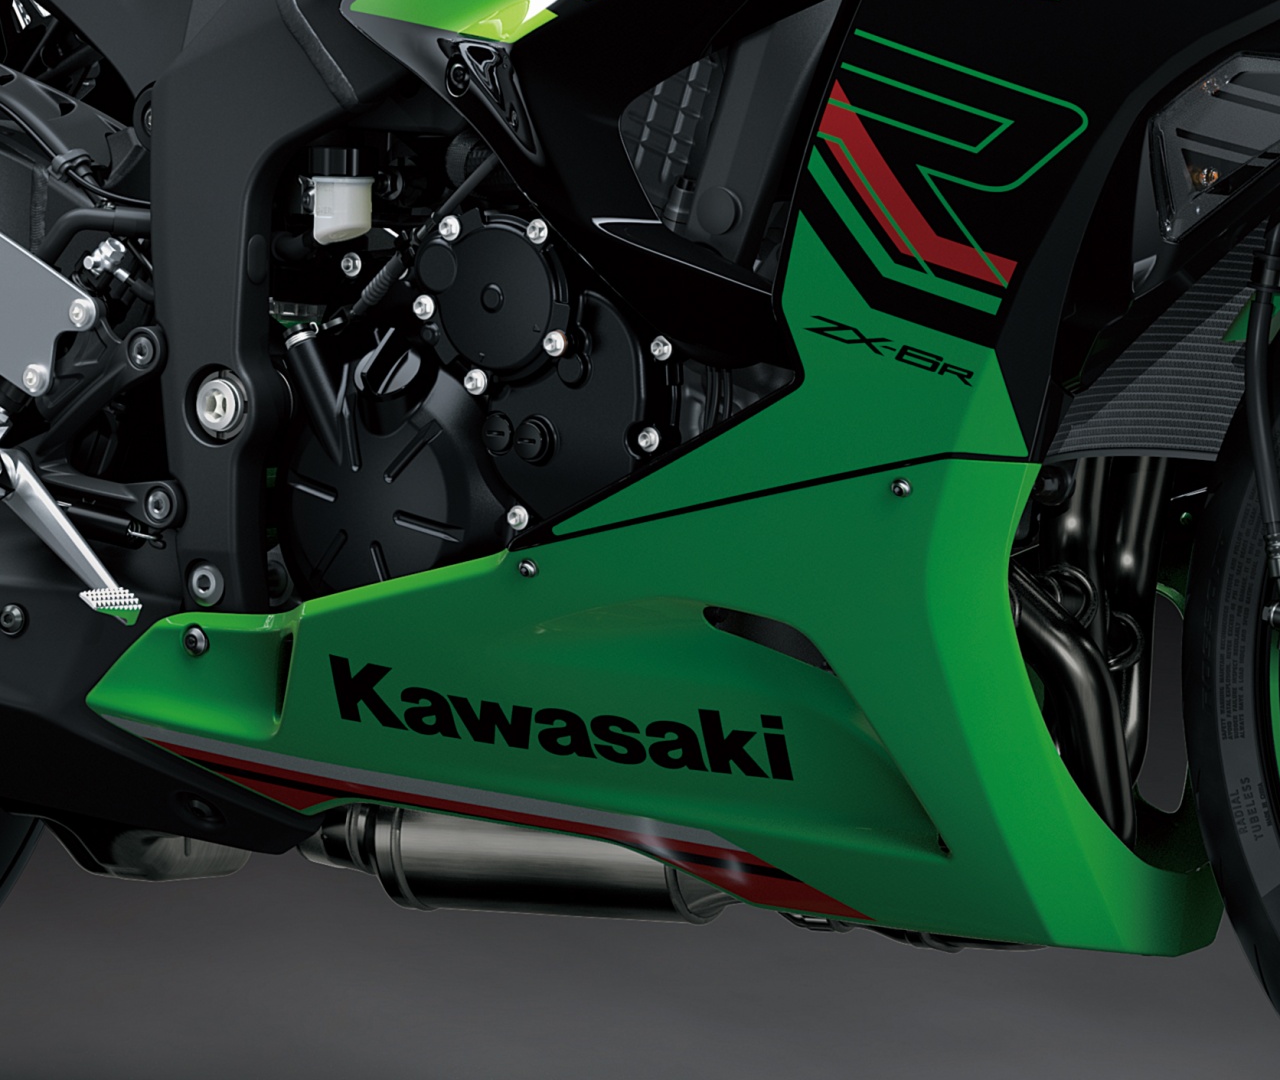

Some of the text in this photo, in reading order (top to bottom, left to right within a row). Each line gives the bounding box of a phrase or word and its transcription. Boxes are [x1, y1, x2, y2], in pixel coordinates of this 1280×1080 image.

[803, 315, 973, 387] ZX-6R
[328, 654, 795, 781] Kawasaki
[1230, 788, 1249, 835] RADIAL
[1239, 777, 1265, 842] TUBELESS
